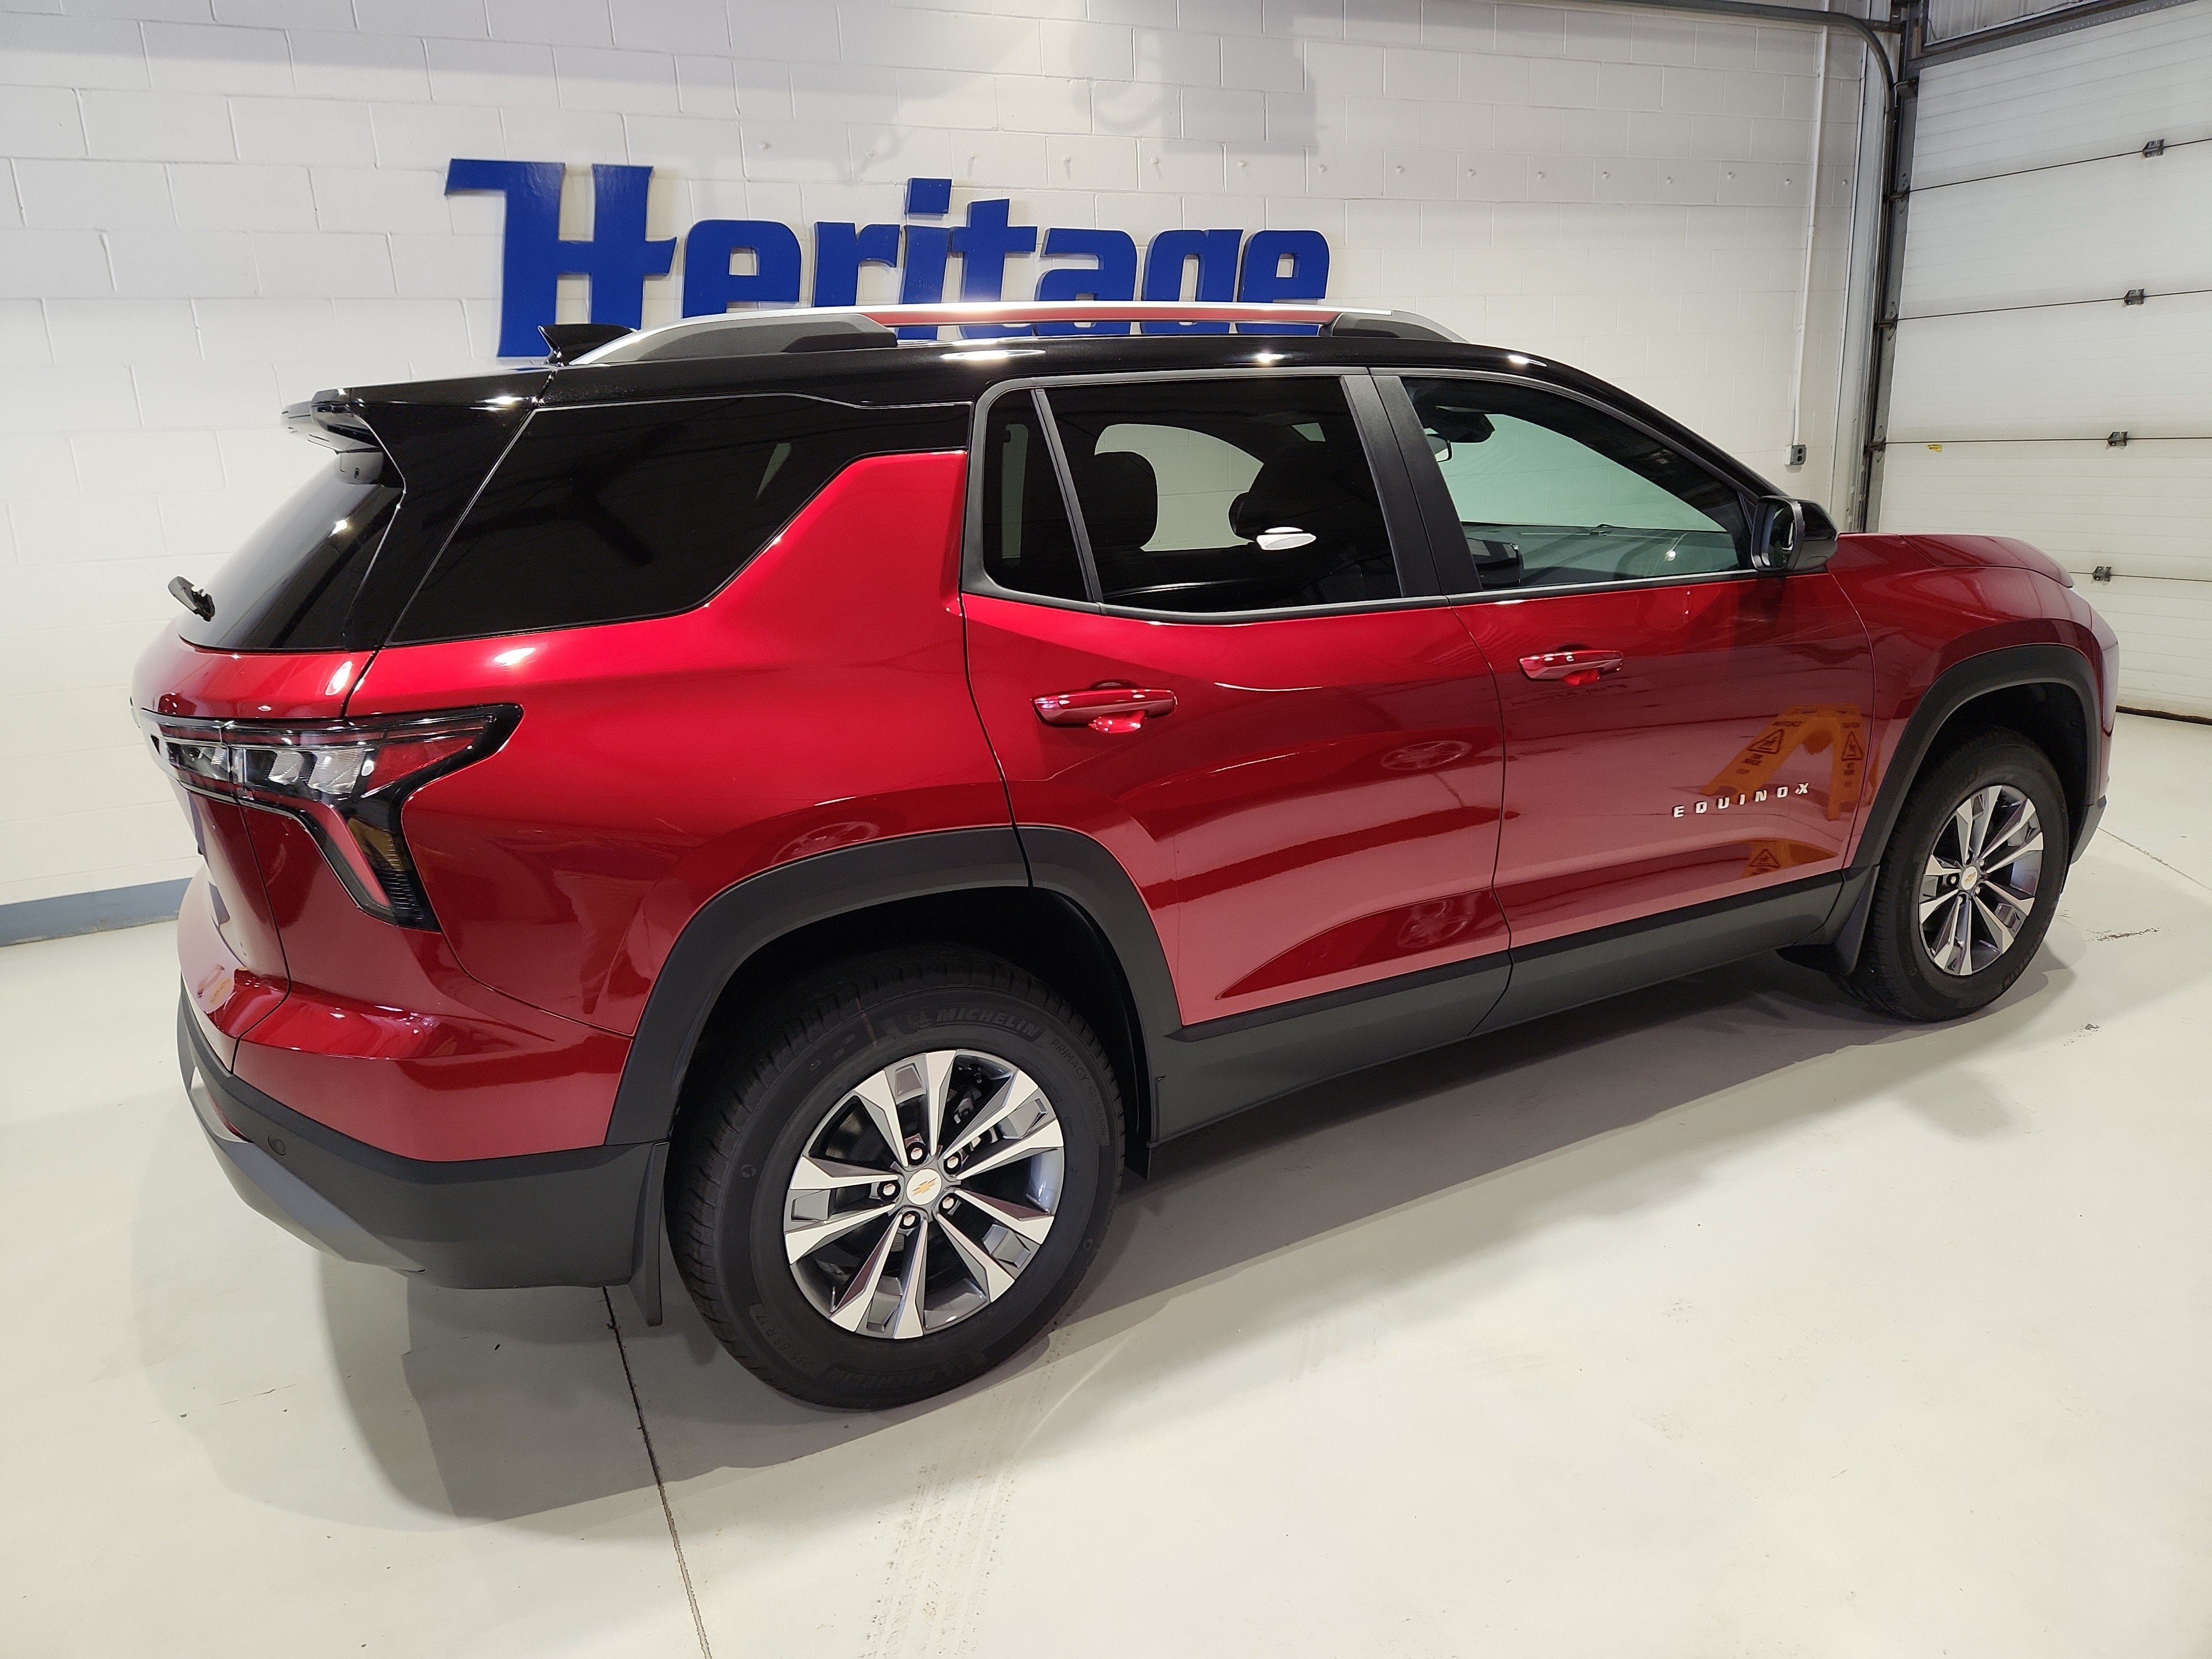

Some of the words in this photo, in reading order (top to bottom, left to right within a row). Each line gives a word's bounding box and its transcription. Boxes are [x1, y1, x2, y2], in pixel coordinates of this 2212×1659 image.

[445, 157, 1330, 357] Heritage
[1673, 782, 1809, 818] EQUINOX
[936, 1007, 1040, 1038] MICHELIN
[1050, 1038, 1090, 1081] PRIMACY
[1095, 1102, 1107, 1136] SEASON
